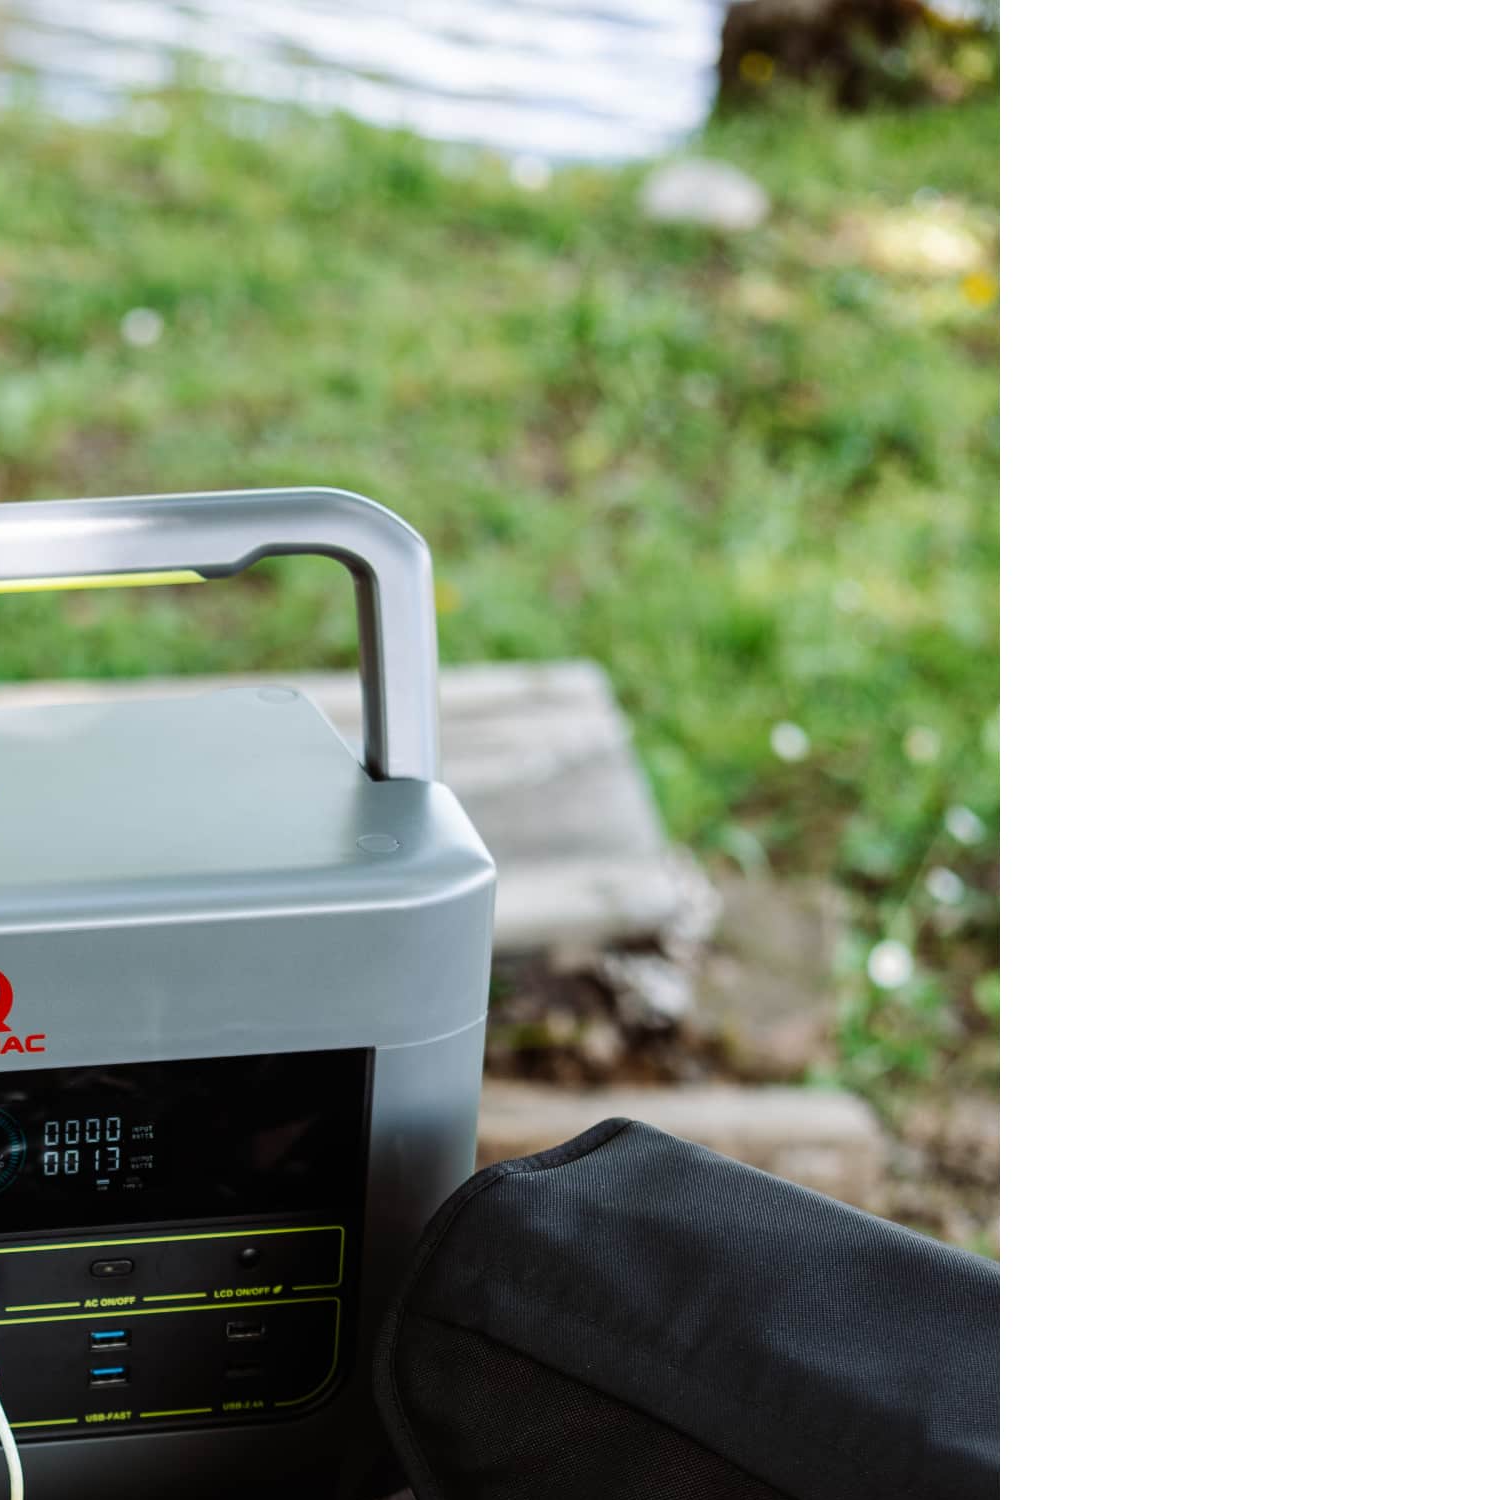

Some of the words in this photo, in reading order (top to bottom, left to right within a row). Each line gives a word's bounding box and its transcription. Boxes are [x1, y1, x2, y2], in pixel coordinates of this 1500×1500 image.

[44, 1117, 121, 1146] 0000
[44, 1146, 120, 1176] 0013
[214, 1288, 233, 1298] LCD
[235, 1286, 270, 1297] ON/OFF
[84, 1298, 98, 1308] AC
[100, 1296, 136, 1308] ON/OFF
[85, 1411, 132, 1423] USB-FAST
